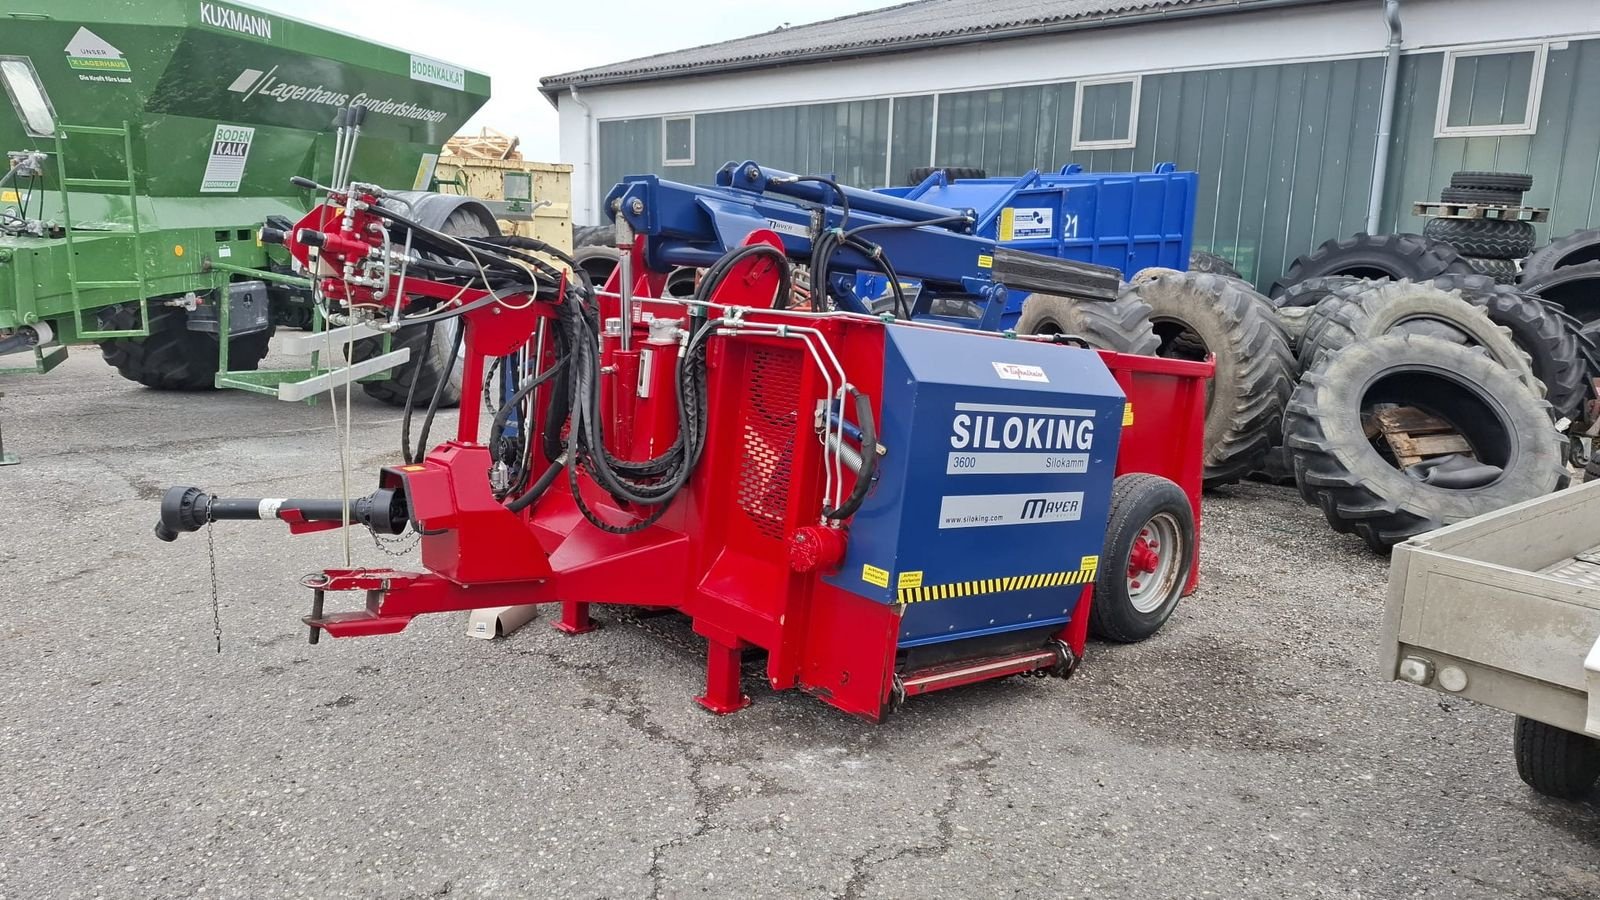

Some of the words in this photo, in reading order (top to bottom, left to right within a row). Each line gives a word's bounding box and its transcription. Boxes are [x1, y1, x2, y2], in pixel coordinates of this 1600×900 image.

[200, 2, 271, 39] KUXMANN
[80, 59, 126, 68] LAGERHAUS
[412, 60, 463, 85] BODENKALK.AT
[259, 76, 350, 106] Lagerhaus
[216, 128, 252, 142] BODEN
[216, 142, 246, 156] KALK
[950, 414, 1094, 450] SILOKING
[953, 457, 976, 468] 3600
[1045, 457, 1085, 468] Silokamm
[1020, 498, 1079, 520] MAYER
[945, 514, 1003, 524] www.siloking.com
